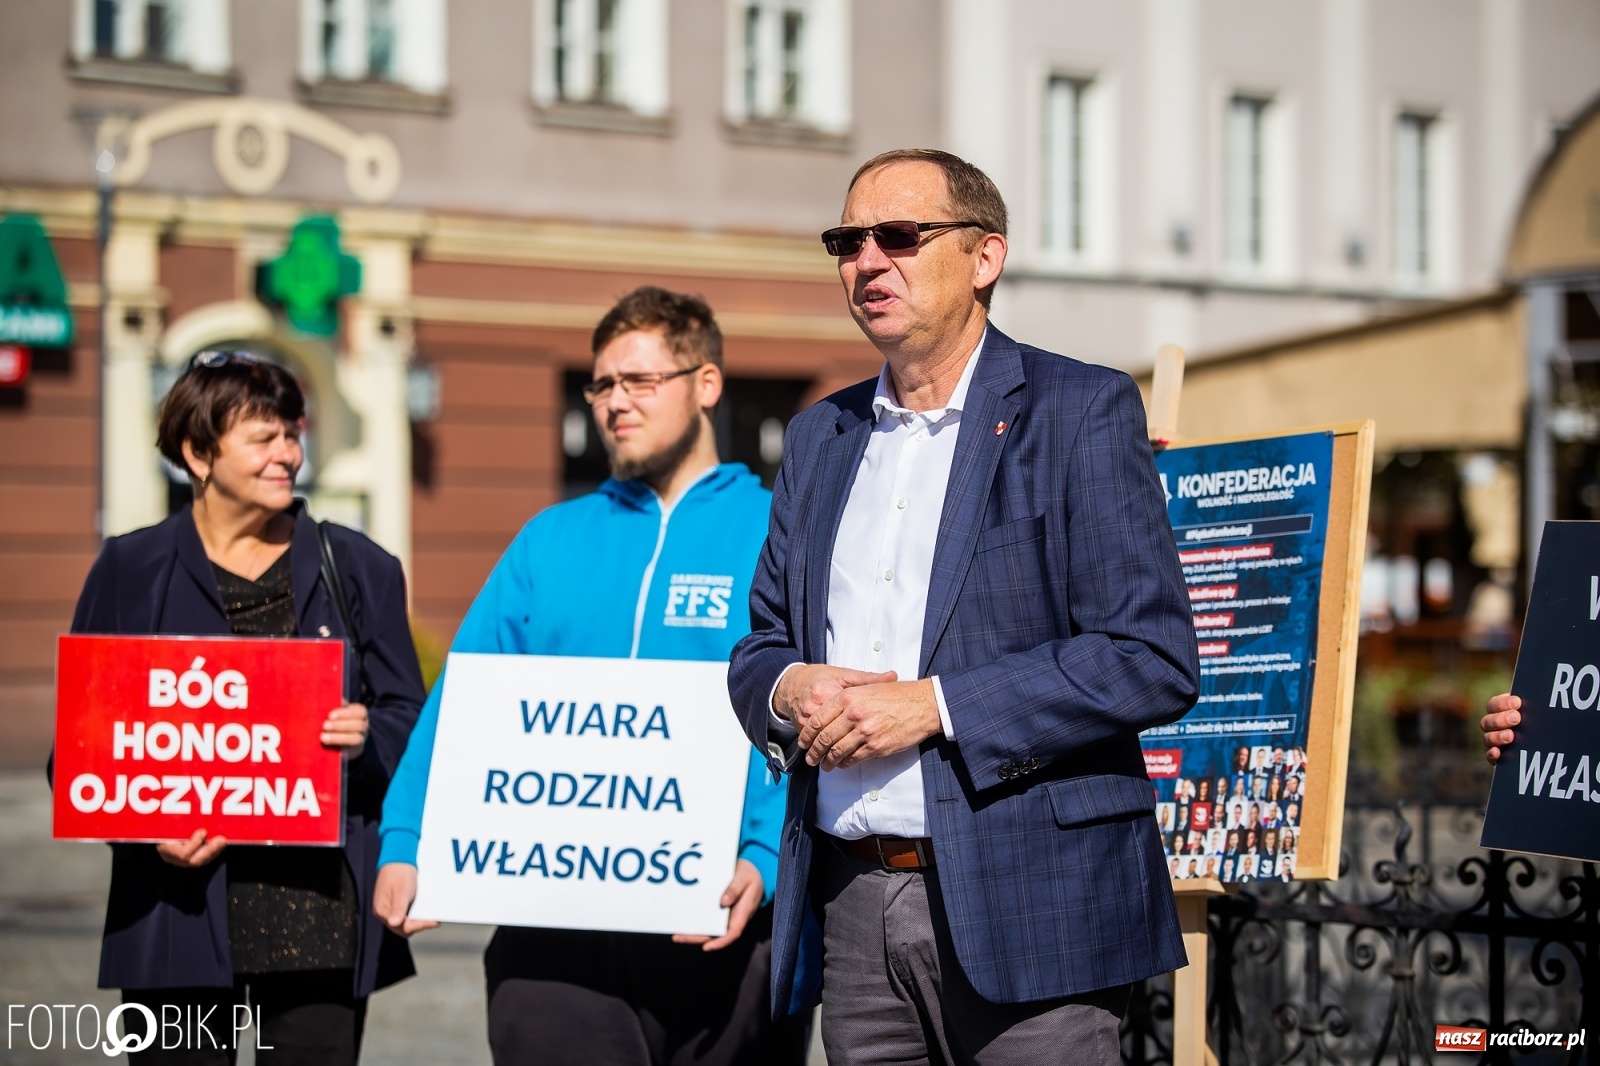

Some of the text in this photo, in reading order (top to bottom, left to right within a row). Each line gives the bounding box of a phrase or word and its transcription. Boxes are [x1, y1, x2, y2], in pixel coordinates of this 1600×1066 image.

[1178, 462, 1316, 498] KONFEDERACJA
[664, 586, 732, 618] FFS
[148, 656, 248, 709] BÓG
[1549, 662, 1600, 711] RO
[520, 700, 670, 740] WIARA
[113, 721, 282, 764] HONOR
[70, 773, 322, 817] OJCZYZNA
[484, 770, 684, 812] RODZINA
[451, 838, 704, 886] WŁASNOŚĆ
